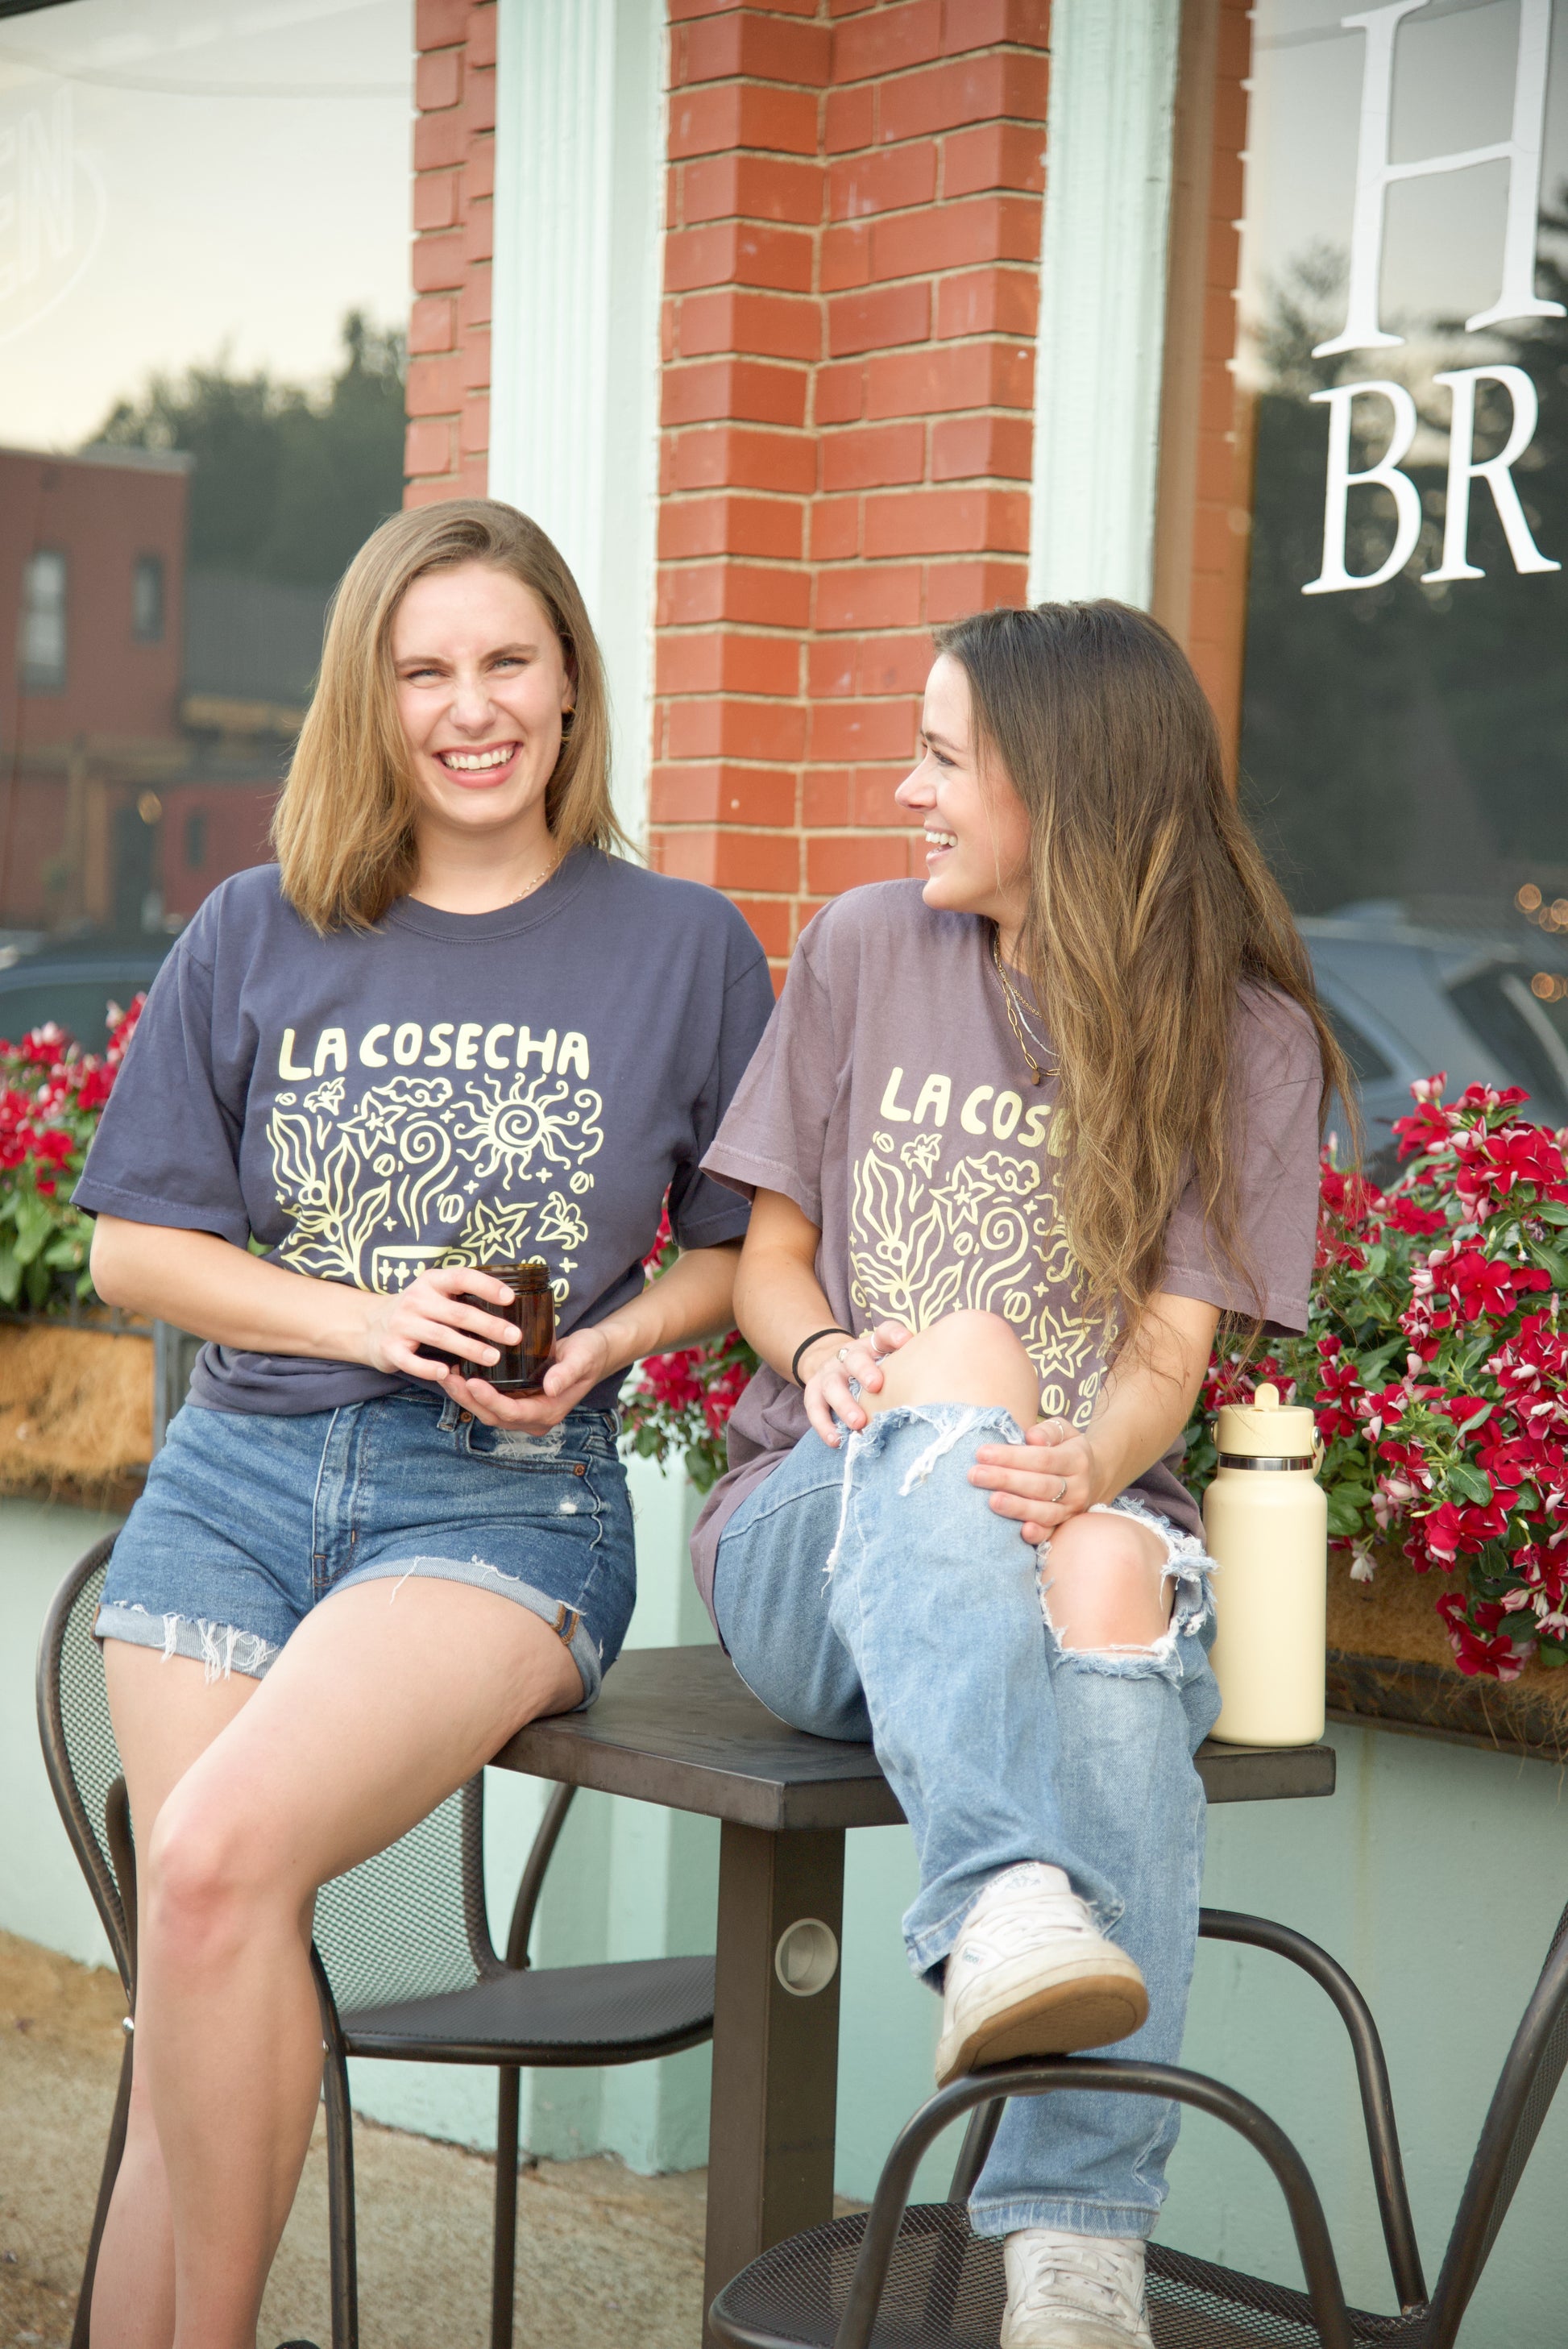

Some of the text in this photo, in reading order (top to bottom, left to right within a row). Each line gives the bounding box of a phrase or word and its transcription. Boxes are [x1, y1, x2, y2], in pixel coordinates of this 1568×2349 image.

[1312, 0, 1568, 359] H
[1300, 364, 1562, 596] BR
[278, 1022, 590, 1081] LA COSECHA
[879, 1066, 1072, 1158] LA COSE
